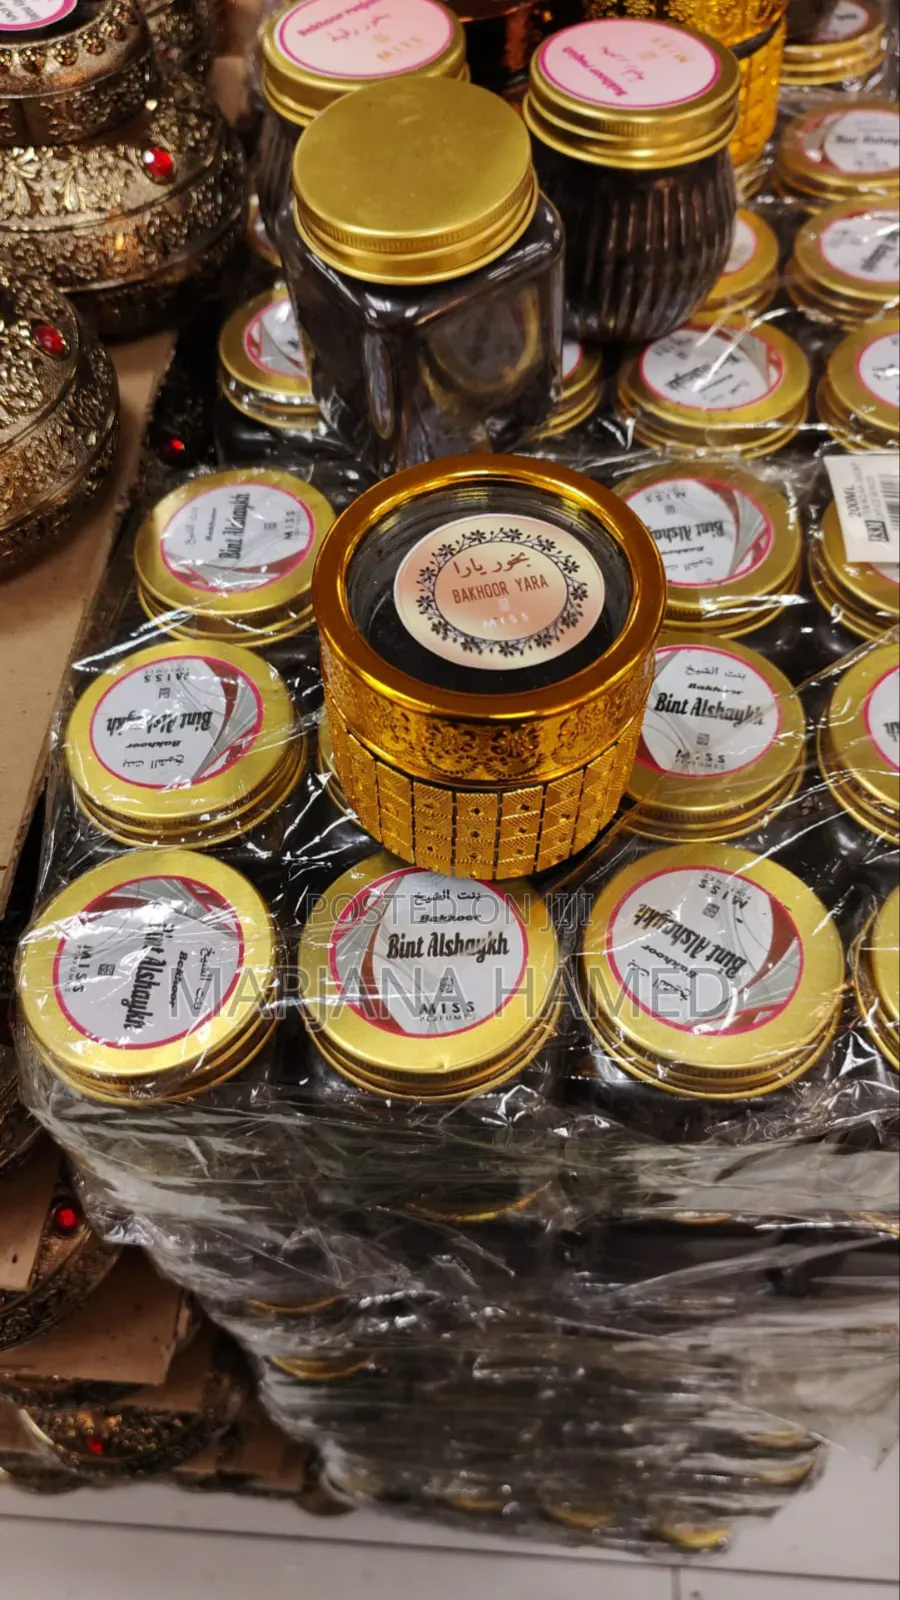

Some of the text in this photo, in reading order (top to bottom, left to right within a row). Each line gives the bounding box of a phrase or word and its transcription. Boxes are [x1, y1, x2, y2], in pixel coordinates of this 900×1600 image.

[283, 509, 296, 541] MISS
[650, 519, 725, 544] Bint Alsha
[218, 534, 243, 560] Bint
[453, 551, 532, 579] بخور يارا
[451, 574, 550, 605] BAKHOOR YARA
[481, 611, 530, 630] MISS
[684, 664, 719, 677] الشيخ
[654, 691, 689, 715] Bint
[179, 710, 214, 733] Bint
[125, 739, 182, 749] Bakhoor
[150, 754, 185, 770] الشيخ
[413, 888, 451, 906] الشيخ
[698, 878, 750, 910] MISS
[418, 912, 482, 924] Bakhoor
[386, 930, 510, 964] Bint Alshaykh
[73, 944, 95, 994] MISS
[640, 943, 699, 980] Bakhoor
[704, 943, 748, 980] Bint
[120, 953, 168, 1031] Alshaykh
[419, 1001, 476, 1016] MISS
